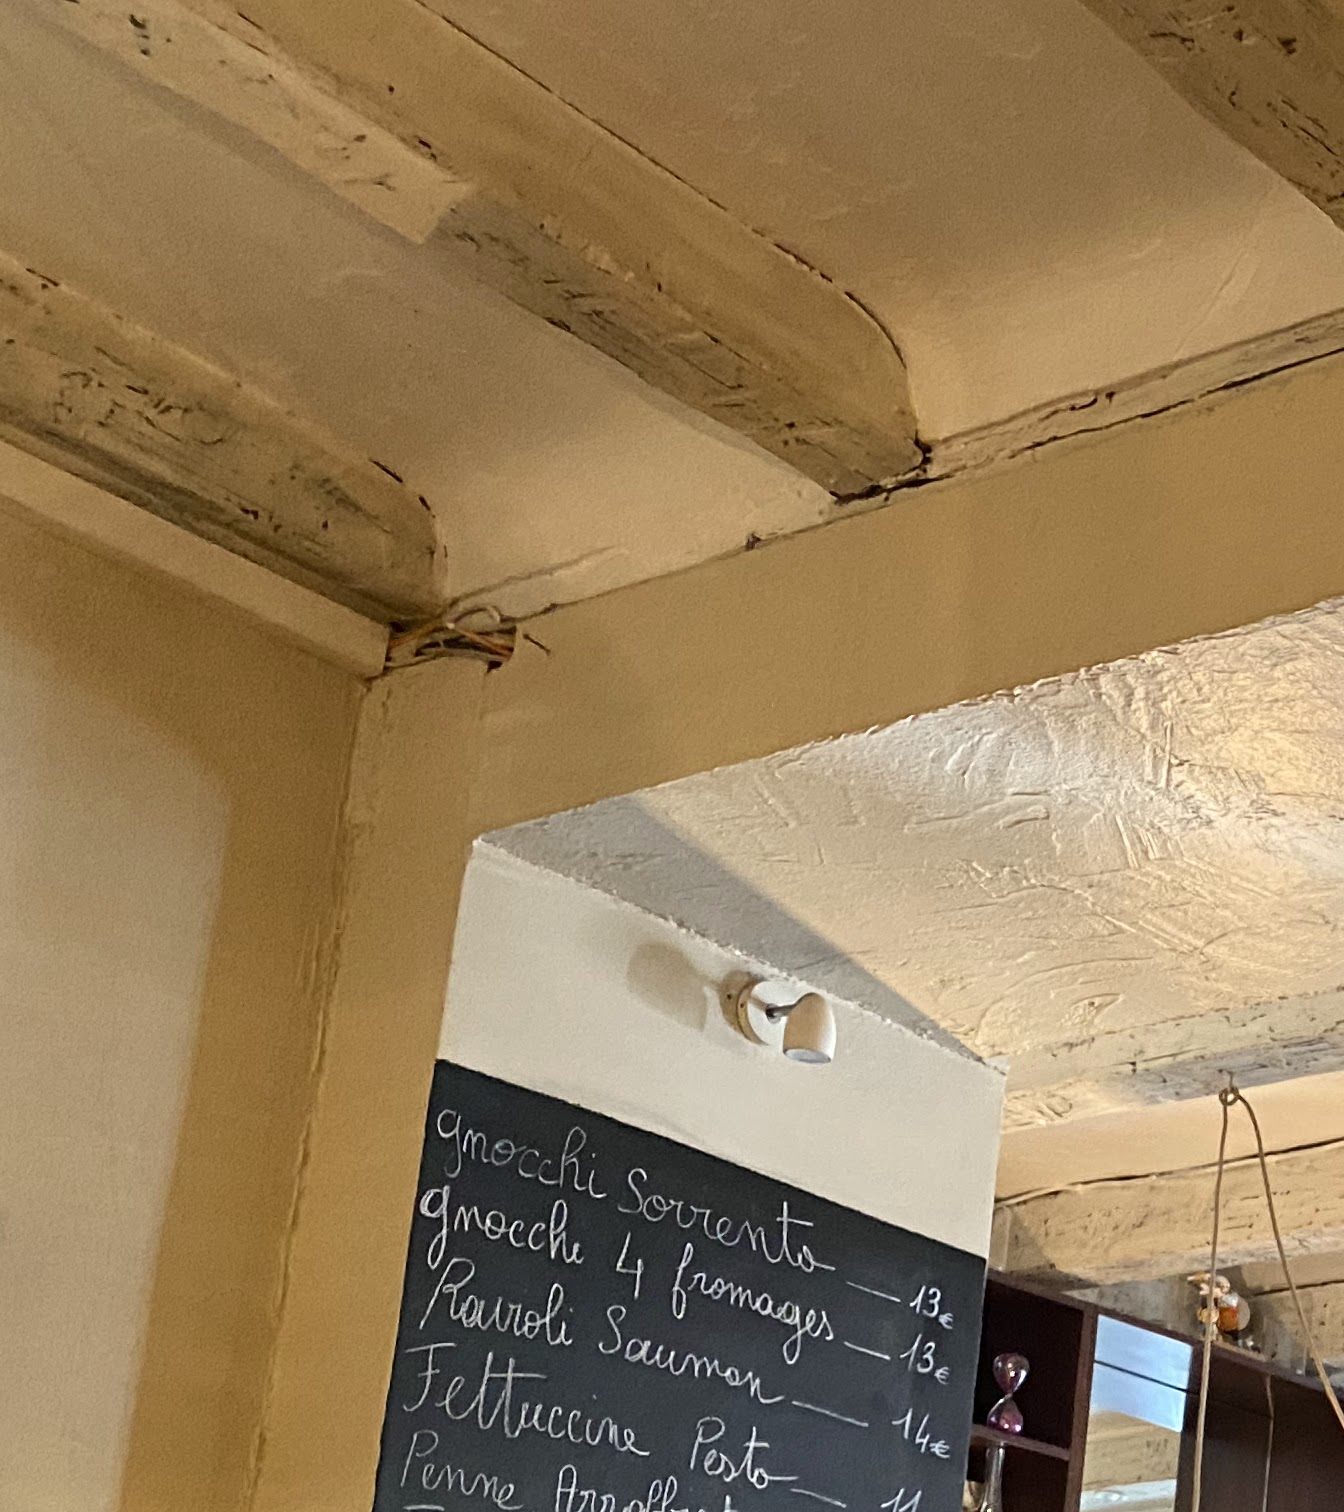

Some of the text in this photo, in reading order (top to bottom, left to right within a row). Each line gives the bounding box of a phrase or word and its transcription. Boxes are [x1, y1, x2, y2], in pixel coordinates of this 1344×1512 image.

[618, 1168, 836, 1273] Sorrento
[615, 1231, 645, 1300] 4
[672, 1243, 834, 1365] fromages
[599, 1304, 785, 1404] Saumon
[403, 1342, 650, 1457] Fettuccine
[690, 1416, 799, 1489] Pesto
[400, 1429, 523, 1510] Penne
